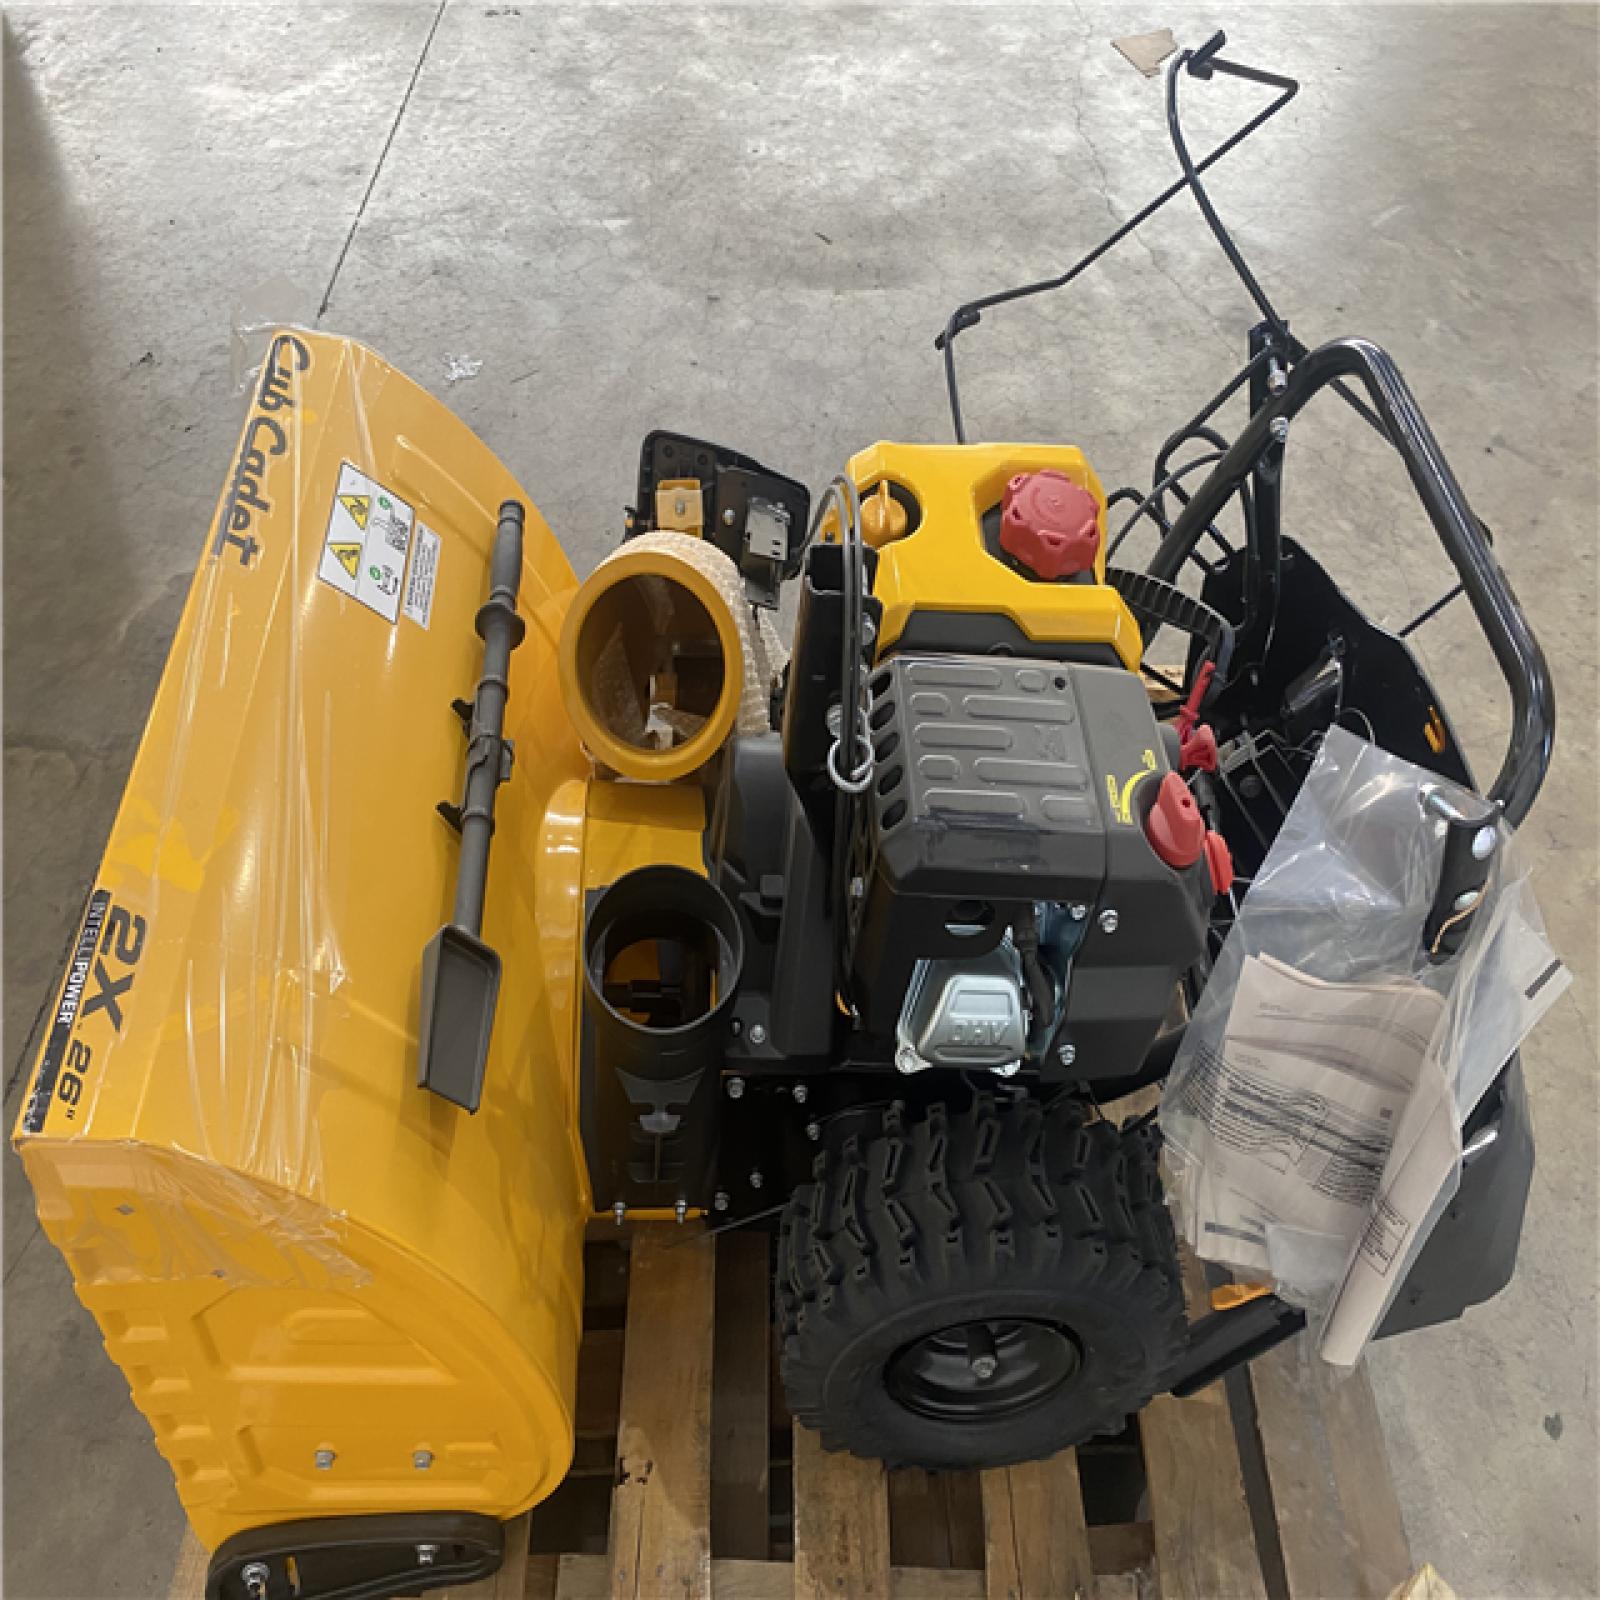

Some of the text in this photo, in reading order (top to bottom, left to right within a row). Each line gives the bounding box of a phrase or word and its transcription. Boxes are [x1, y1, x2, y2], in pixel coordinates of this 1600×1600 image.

[209, 335, 309, 566] Cub Cadet
[57, 901, 106, 1025] INTELLIPOWER
[58, 1039, 91, 1120] 26"
